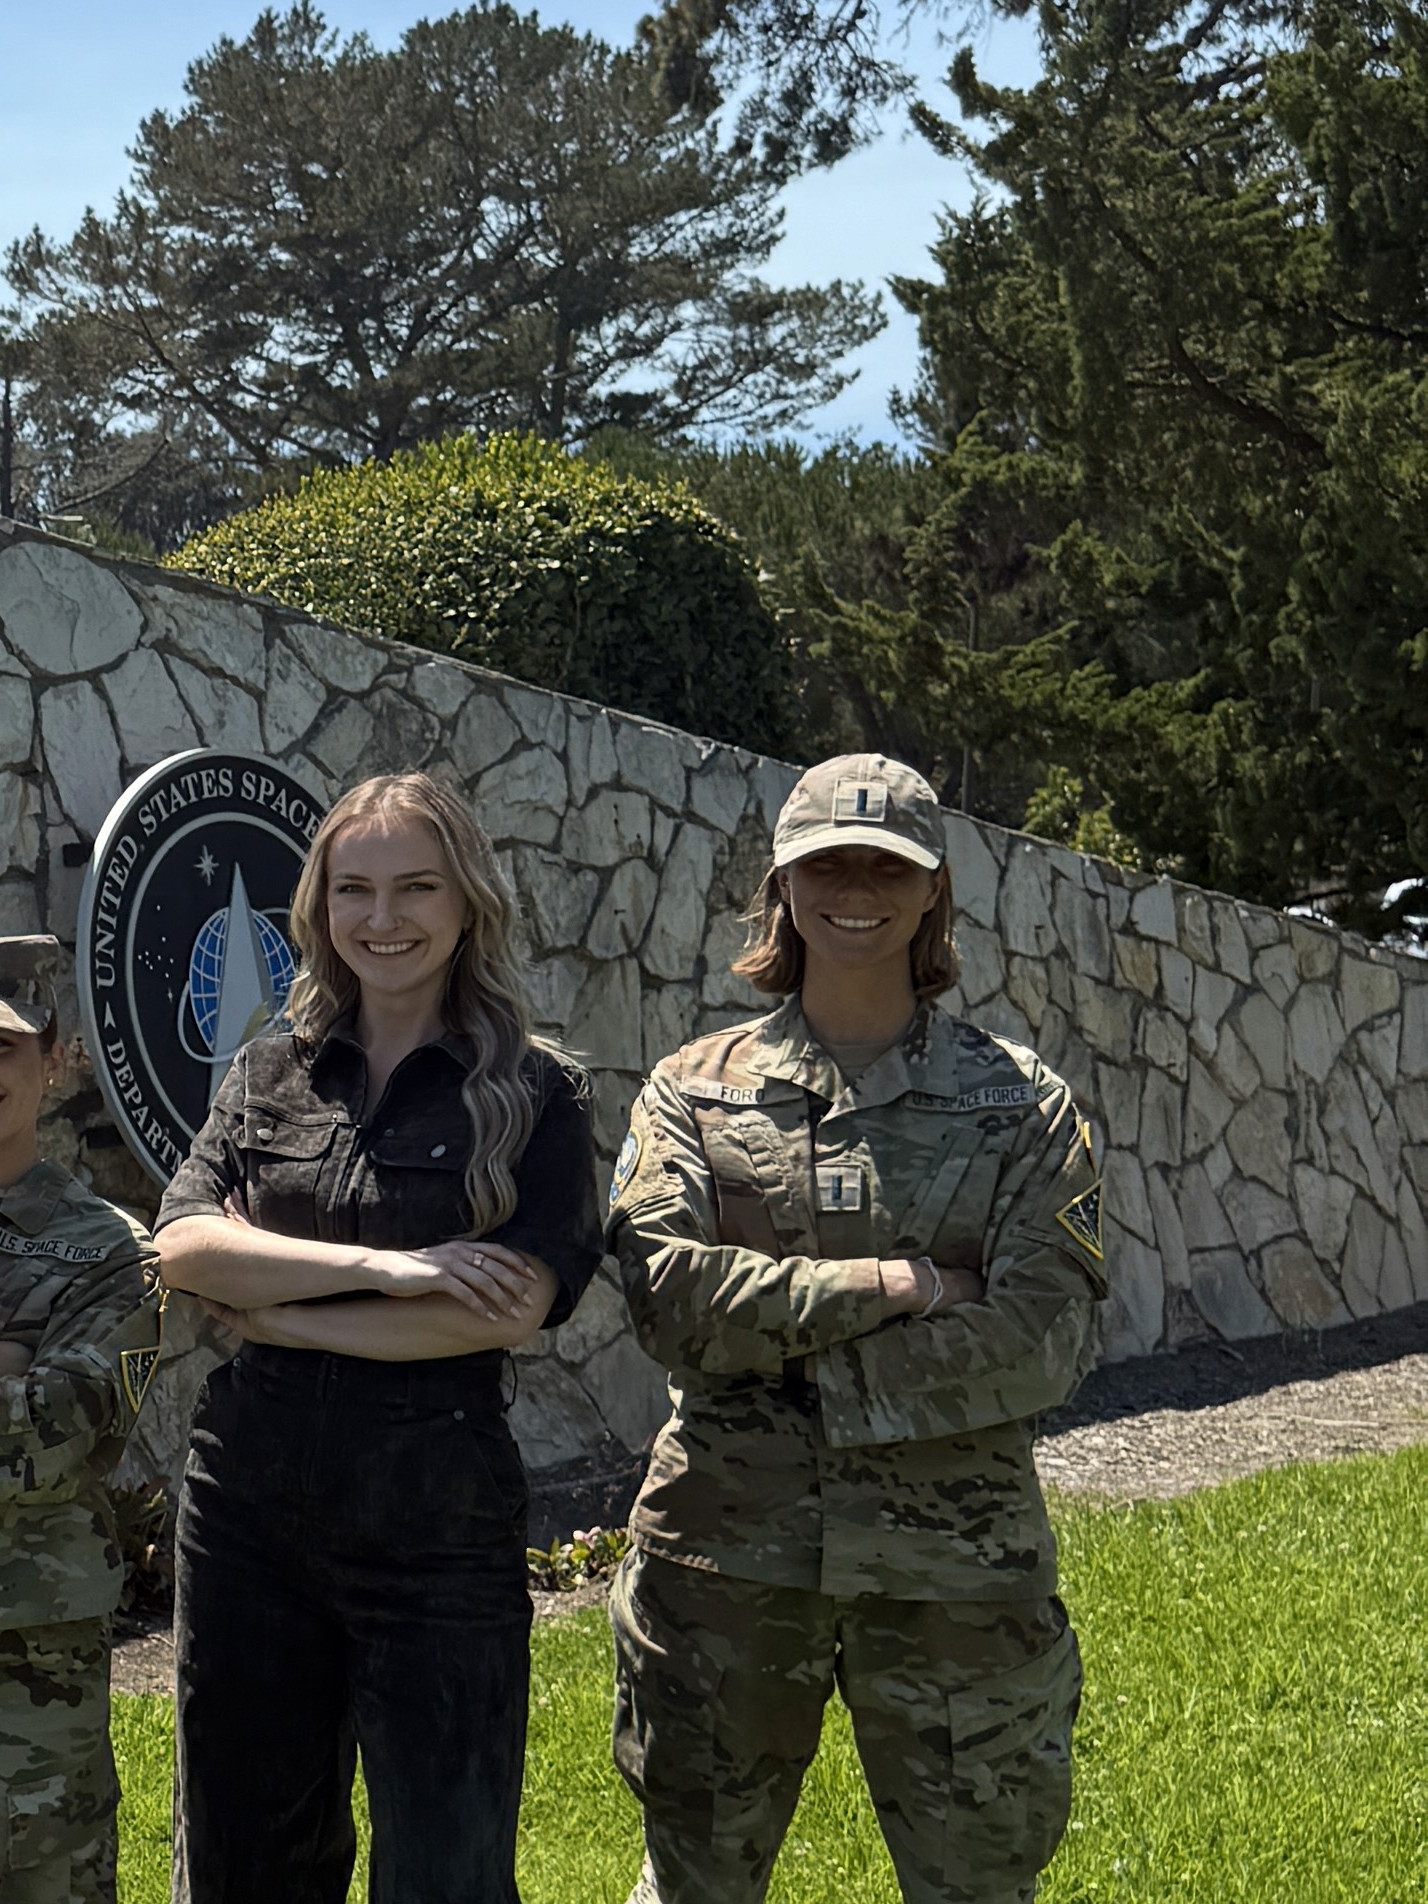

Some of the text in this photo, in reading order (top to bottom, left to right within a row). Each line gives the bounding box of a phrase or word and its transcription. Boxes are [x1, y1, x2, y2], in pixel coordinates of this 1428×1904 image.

[94, 767, 321, 990] UNITED STATES SPACE
[939, 1095, 981, 1110] SPACE
[984, 1085, 1028, 1105] FORCE
[21, 1239, 64, 1256] SPACE
[64, 1244, 107, 1262] FORCE
